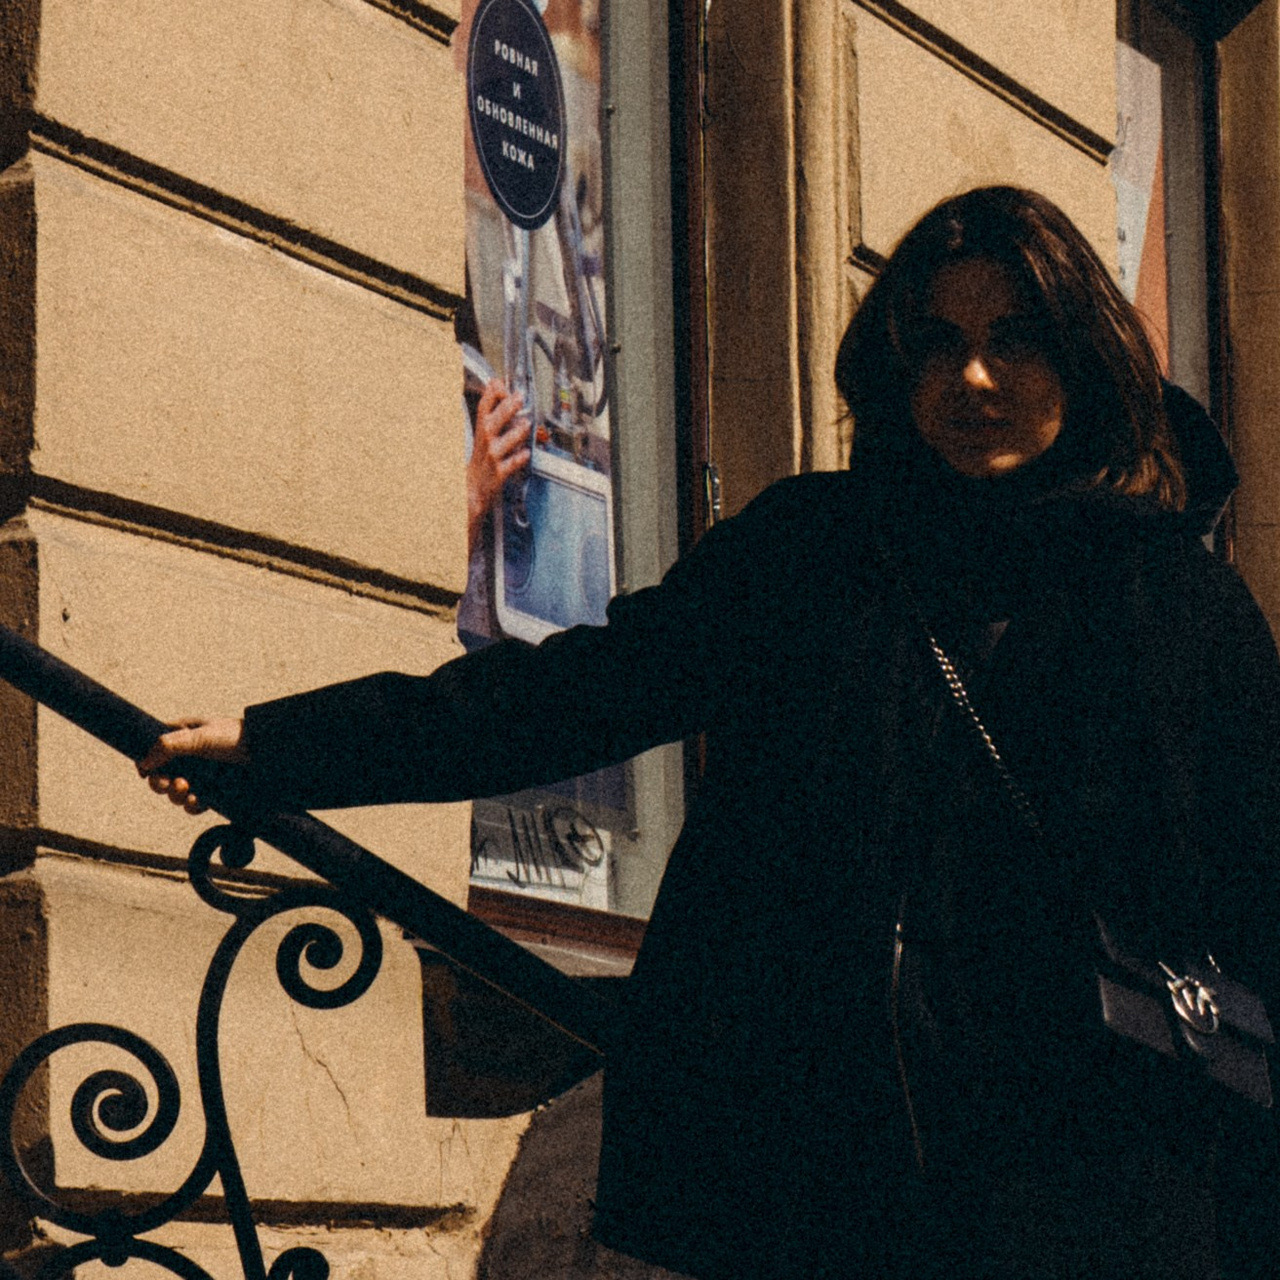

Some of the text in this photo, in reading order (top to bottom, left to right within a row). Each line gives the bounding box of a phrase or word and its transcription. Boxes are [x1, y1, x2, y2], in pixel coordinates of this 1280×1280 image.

[494, 39, 539, 77] РОВНАЯ
[512, 81, 521, 100] И
[476, 95, 558, 150] ОБНОВЛЕННАЯ
[501, 140, 535, 172] КОЖА
